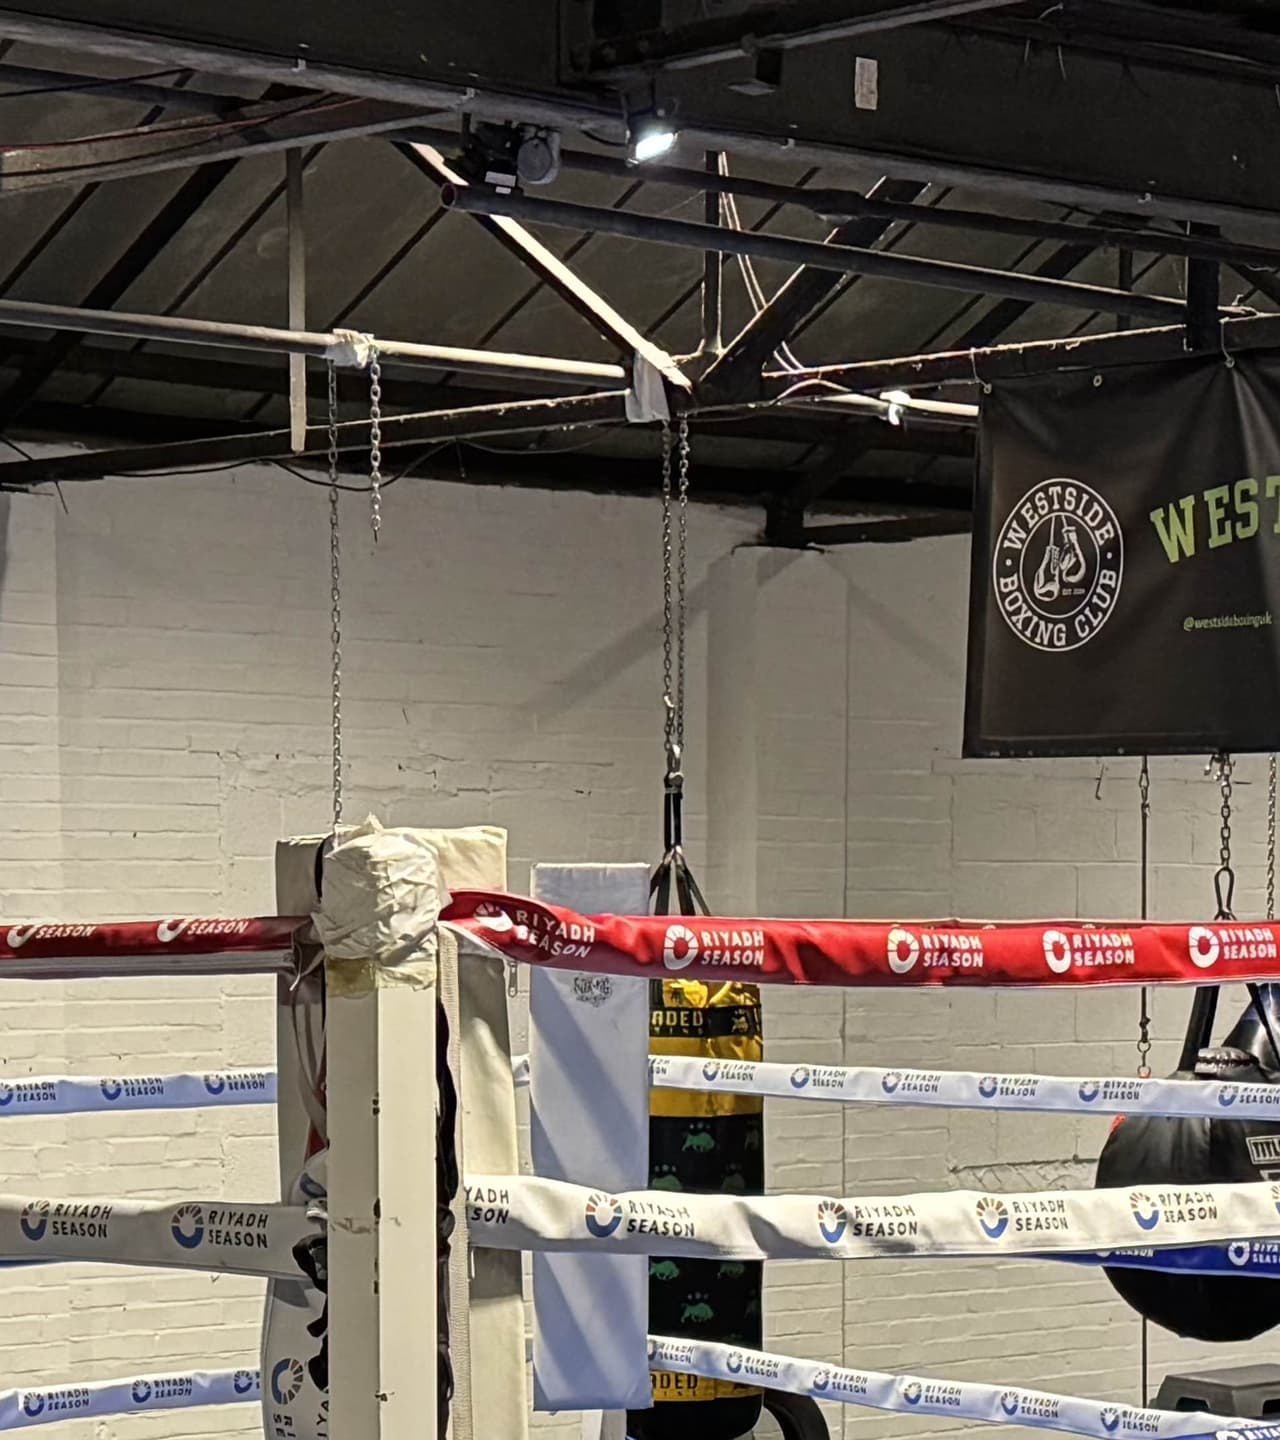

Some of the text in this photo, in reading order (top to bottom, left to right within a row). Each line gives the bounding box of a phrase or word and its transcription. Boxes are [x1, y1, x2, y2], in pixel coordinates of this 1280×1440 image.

[1003, 486, 1114, 550] WESTSIDE
[1000, 569, 1117, 645] BOXING CLUB
[515, 909, 595, 943] RIYADH
[701, 929, 765, 948] RIYADH
[923, 934, 983, 951] RIYADH
[1073, 933, 1134, 949] RIYADH
[1220, 928, 1274, 943] RIYADH
[701, 949, 765, 965] SEASON
[923, 951, 983, 968] SEASON
[1074, 948, 1135, 966] SEASON
[1224, 943, 1277, 959] SEASON
[54, 1203, 112, 1219] RIYADH
[629, 1200, 691, 1219] RIYADH
[855, 1203, 915, 1220] RIYADH
[1013, 1201, 1065, 1214] RIYADH
[209, 1209, 268, 1230] RIYADH
[1015, 1215, 1068, 1231] SEASON
[52, 1220, 107, 1239] SEASON
[627, 1219, 695, 1238] SEASON
[853, 1221, 918, 1236] SEASON
[209, 1230, 268, 1248] SEASON
[47, 1388, 89, 1402] RIYADH
[48, 1399, 89, 1411] SEASON
